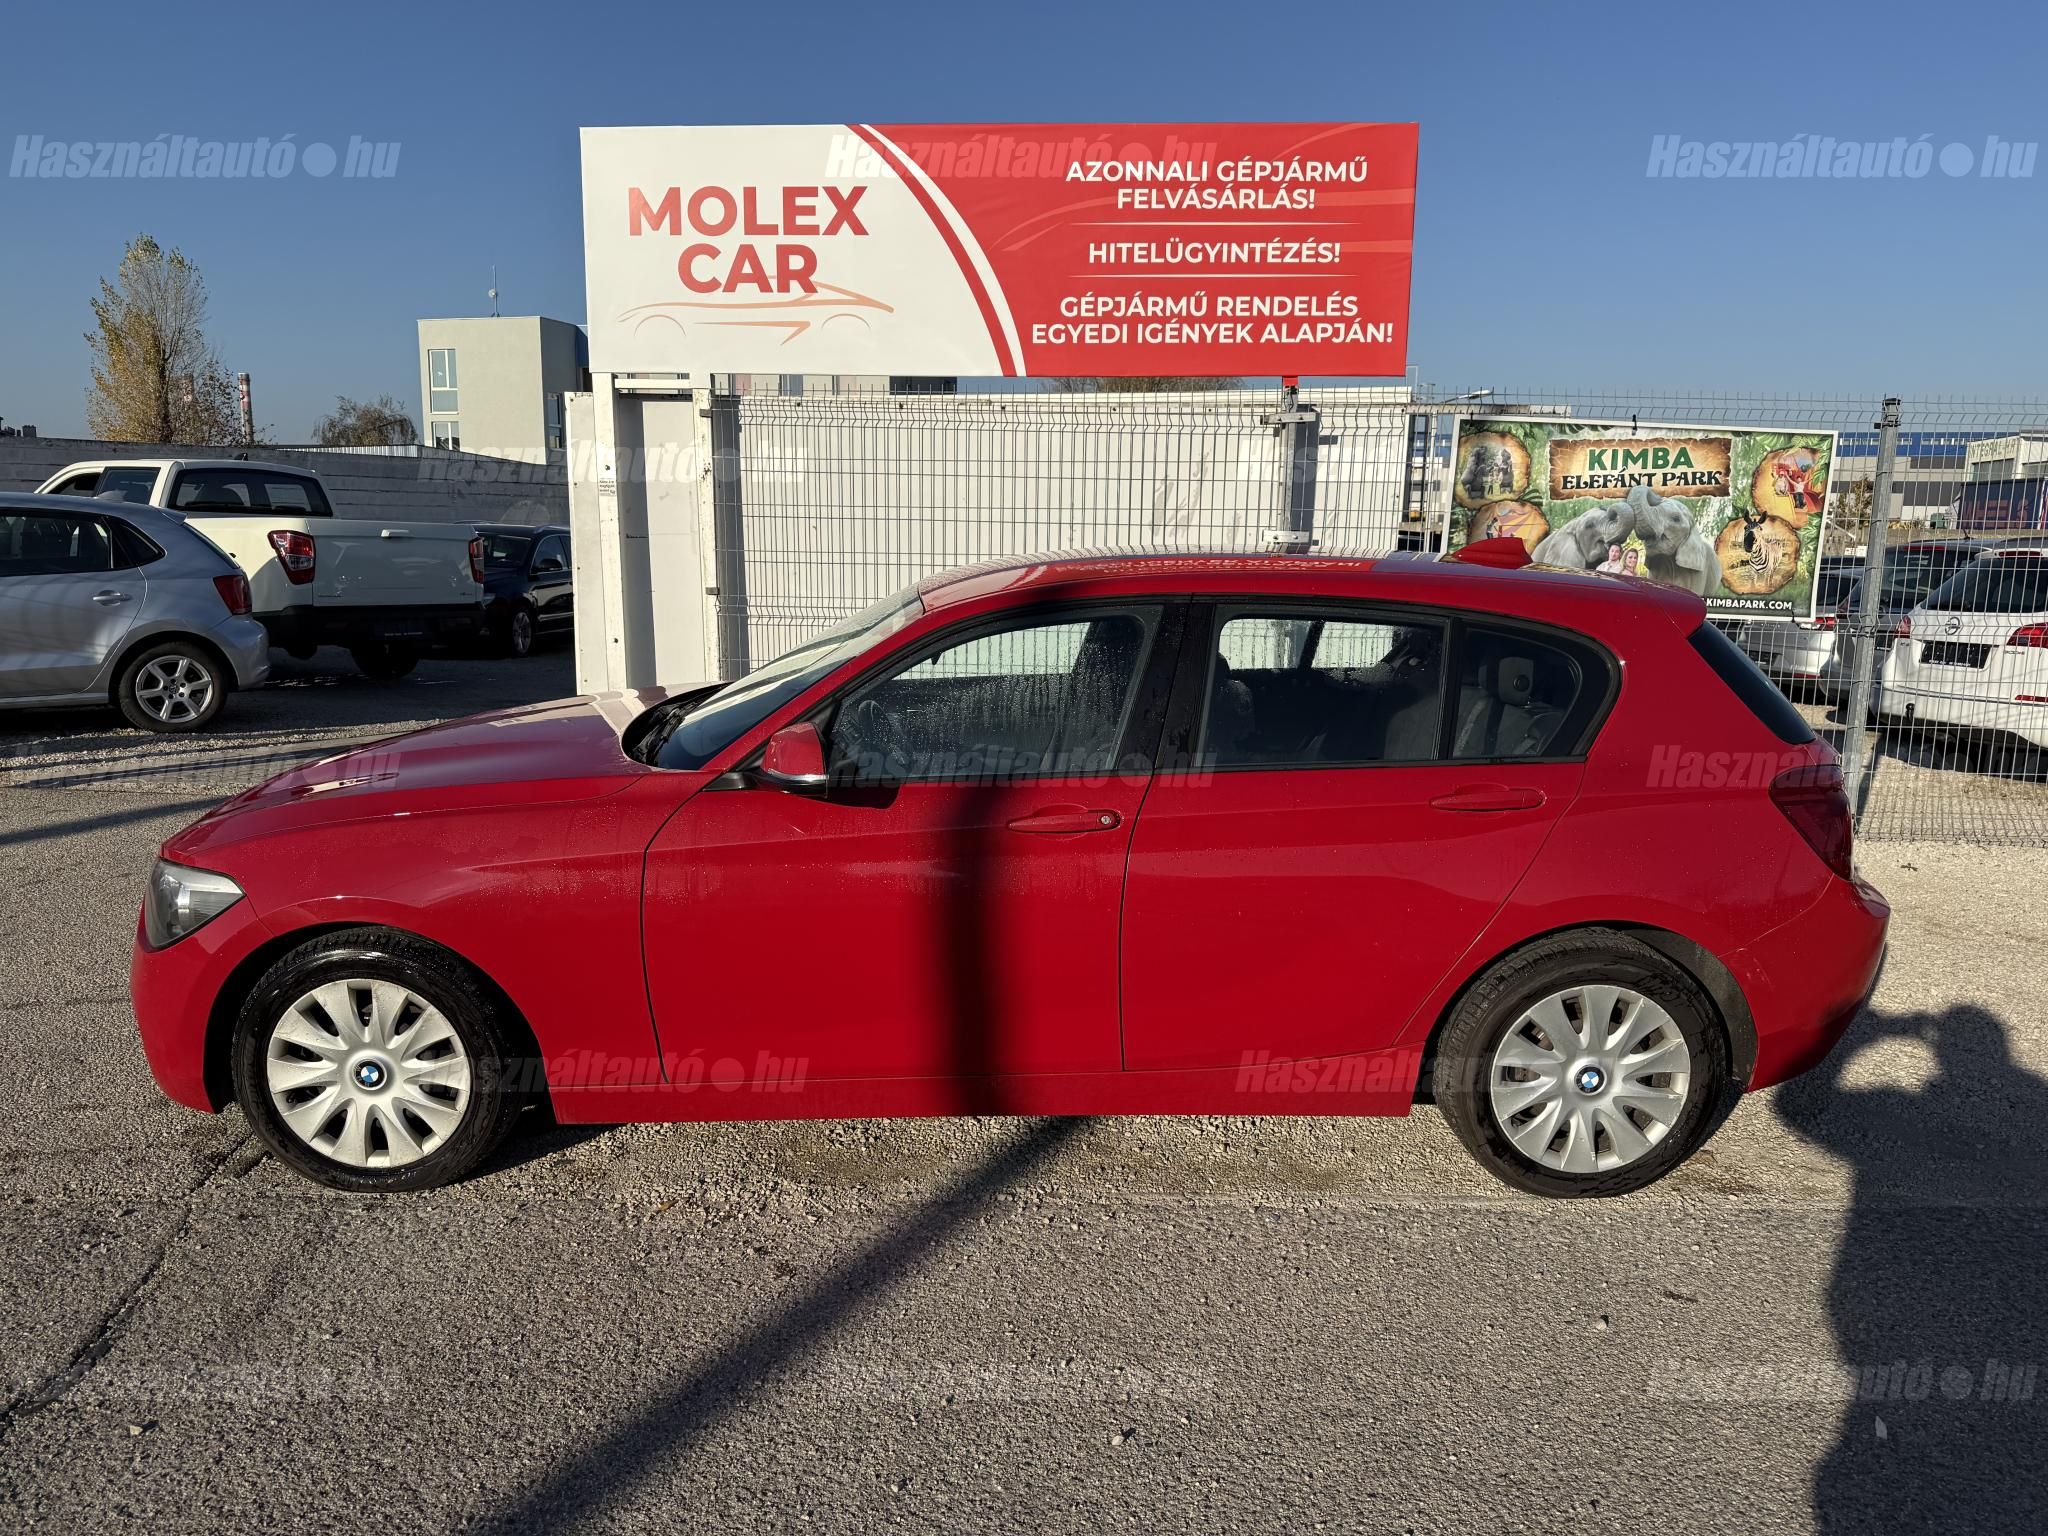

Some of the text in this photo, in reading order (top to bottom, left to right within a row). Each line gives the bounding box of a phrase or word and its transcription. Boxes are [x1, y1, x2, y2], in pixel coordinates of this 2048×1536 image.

[1066, 155, 1368, 183] AZONNALI GÉPJÁRMŰ
[1117, 183, 1315, 209] FELVÁSÁRLÁS!
[628, 186, 869, 236] MOLEX
[1089, 237, 1341, 263] HITELÜGYINTÉZÉS!
[677, 243, 818, 293] CAR
[1060, 290, 1358, 317] GÉPJÁRMŰ RENDELÉS
[1032, 318, 1393, 344] EGYEDI IGÉNYEK ALAPJÁN!
[1588, 447, 1694, 471] KIMBA
[1561, 467, 1722, 490] ELEFÁNT PARK
